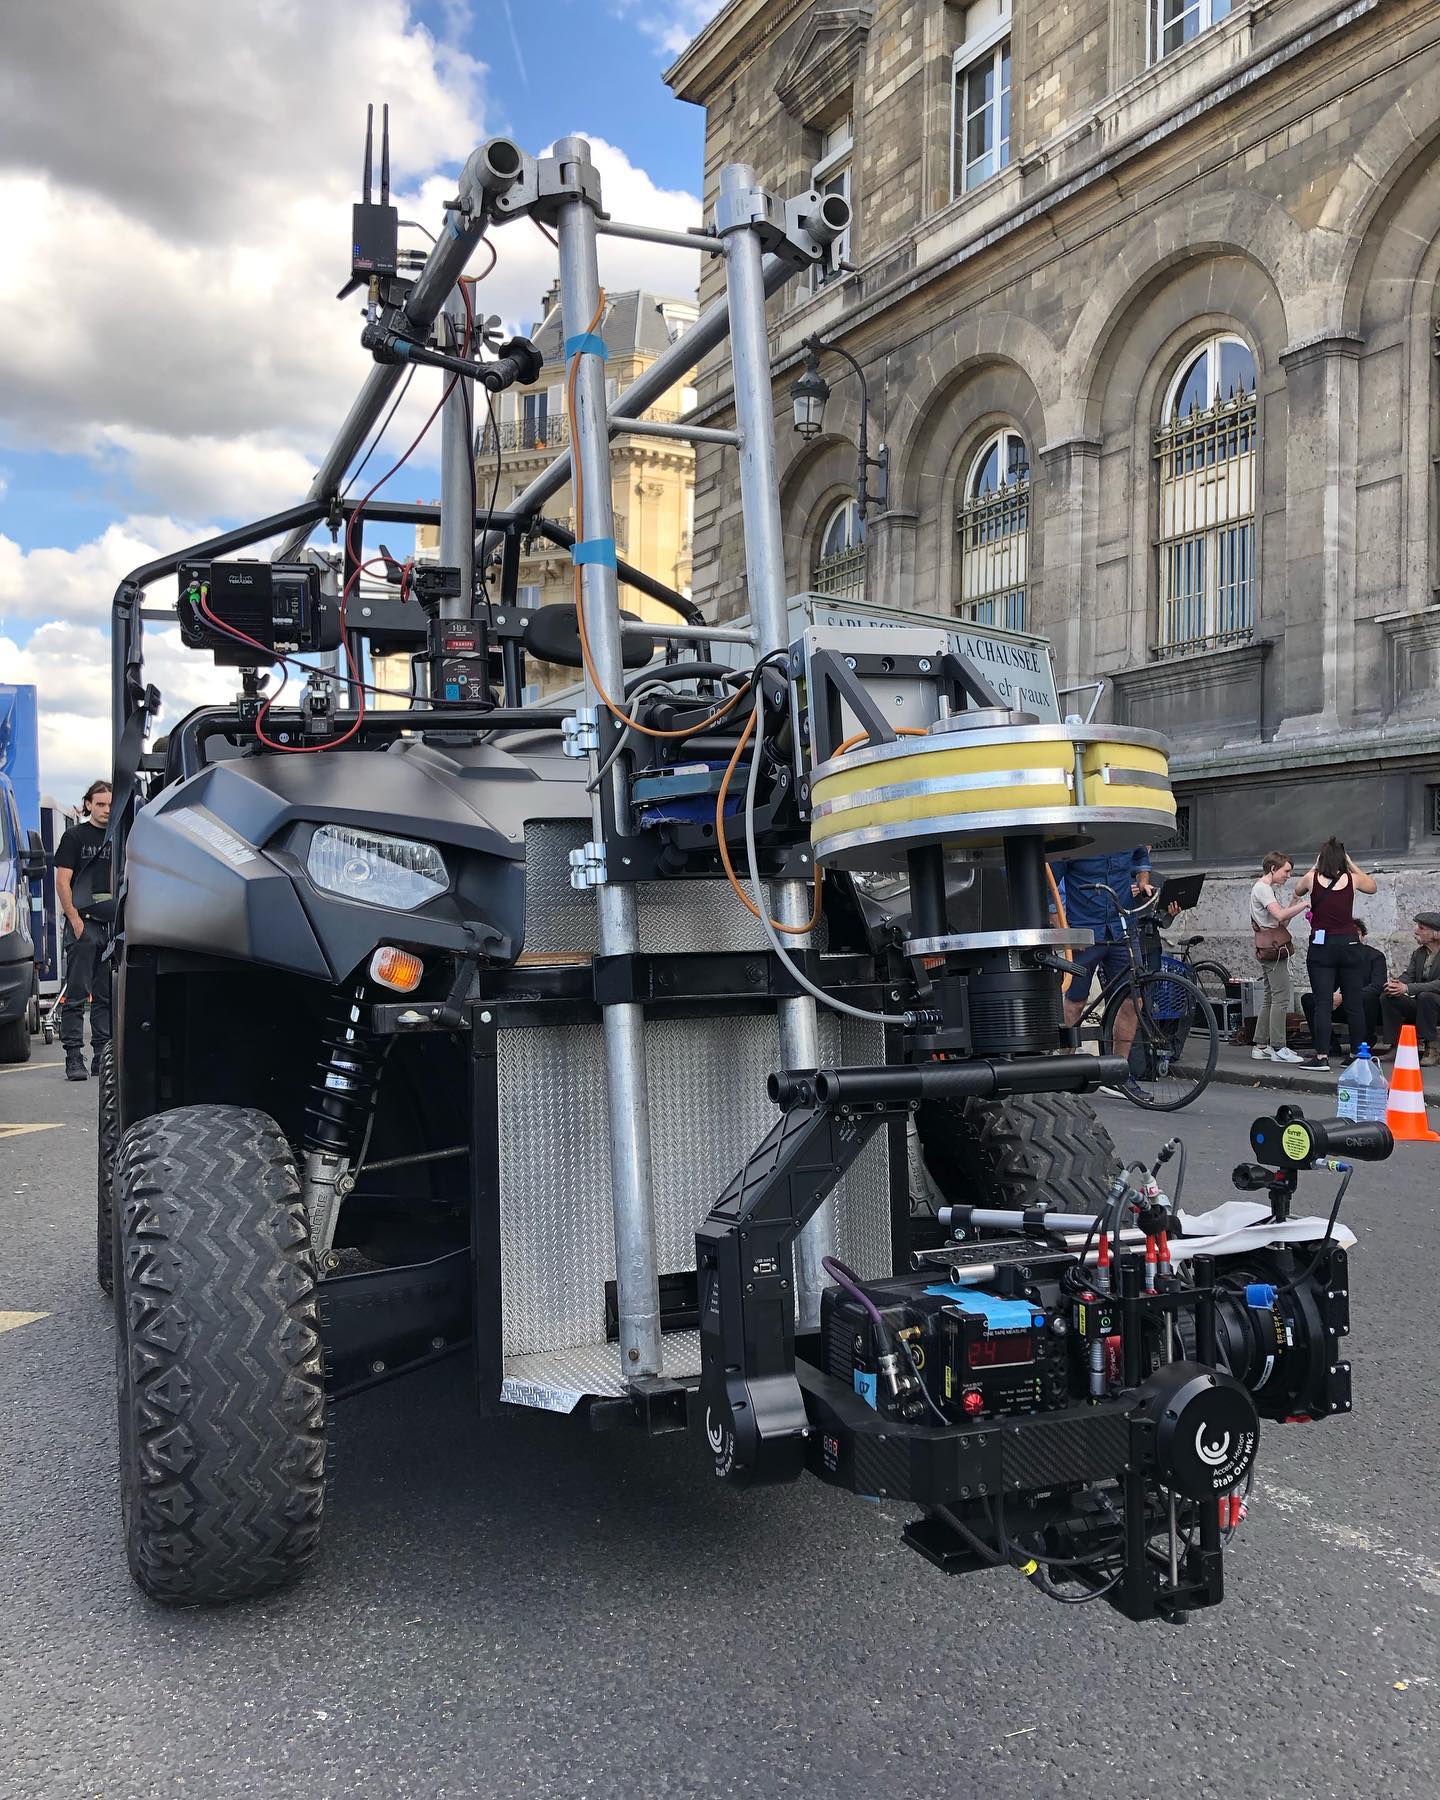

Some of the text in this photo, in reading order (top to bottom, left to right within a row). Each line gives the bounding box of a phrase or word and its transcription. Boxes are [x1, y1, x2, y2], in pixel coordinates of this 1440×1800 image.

[955, 635, 975, 658] LA
[976, 639, 1041, 673] CHAUSSEE
[998, 677, 1050, 706] chvaux
[1213, 1433, 1245, 1477] Access Motion
[1213, 1431, 1254, 1488] Stab One Mk2
